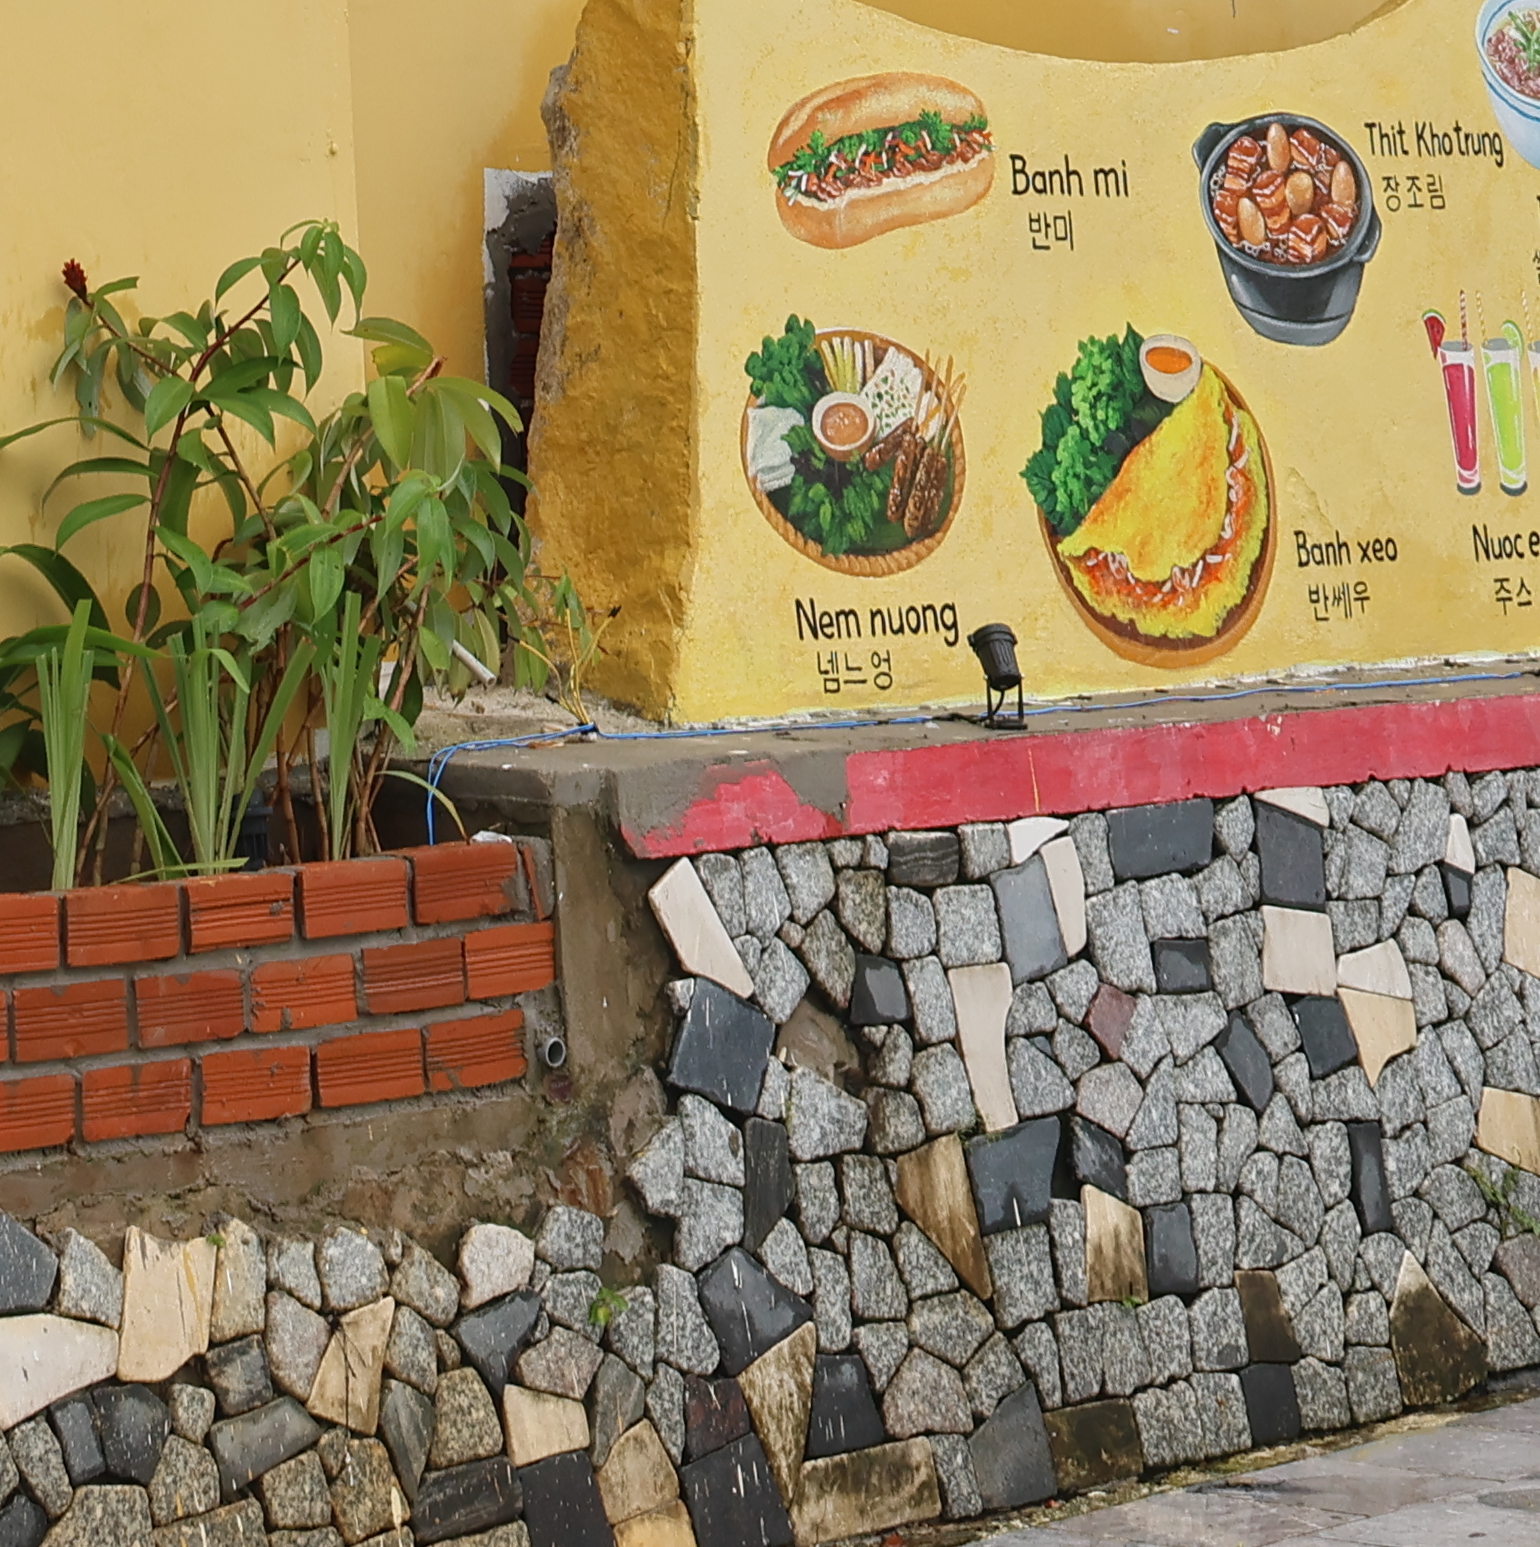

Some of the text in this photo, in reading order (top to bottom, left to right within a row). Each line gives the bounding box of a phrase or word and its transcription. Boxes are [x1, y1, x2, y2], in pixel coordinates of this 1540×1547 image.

[1364, 121, 1410, 157] Thit
[1009, 153, 1129, 198] Banh mi
[1382, 174, 1447, 212] 장조림
[1028, 209, 1074, 251] 반미
[1293, 529, 1399, 568] Banh xeo
[1472, 523, 1525, 563] Nuoc
[1308, 580, 1371, 622] 반쎄우
[1493, 576, 1533, 616] 주스
[795, 597, 960, 648] Nem nuong
